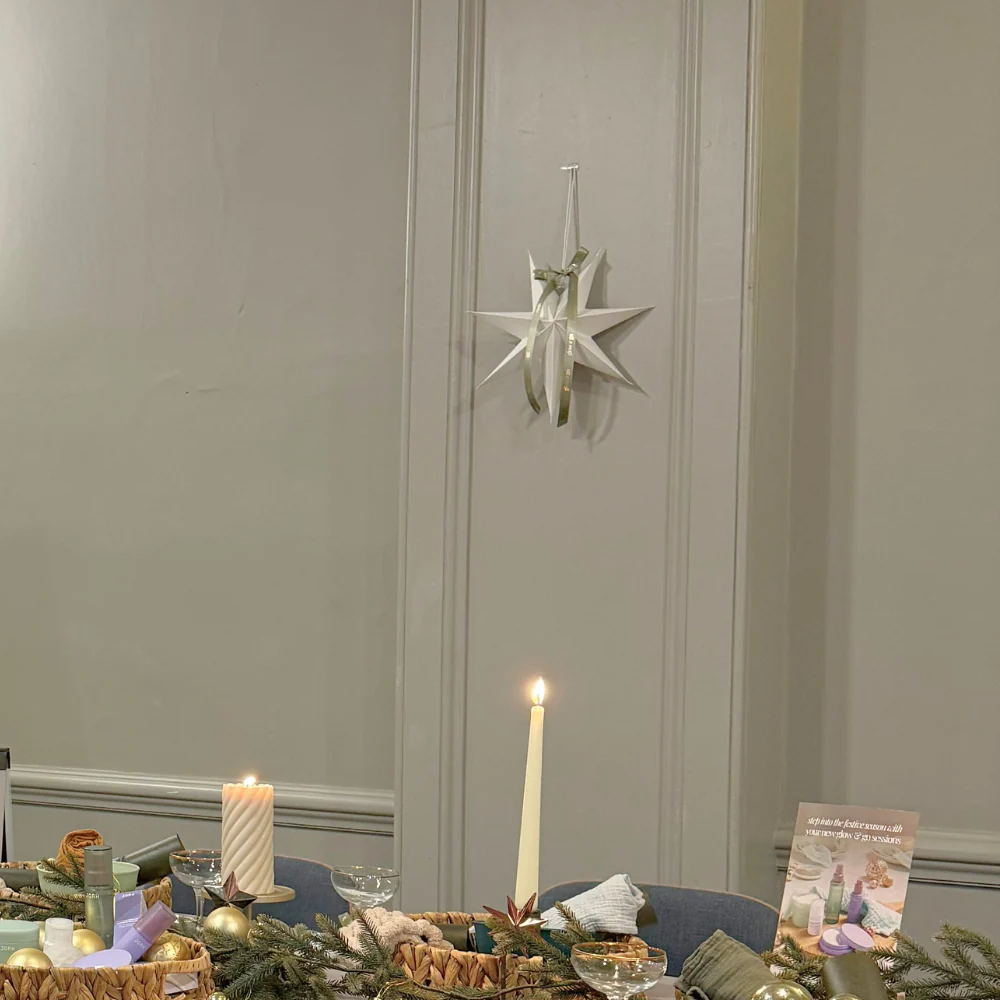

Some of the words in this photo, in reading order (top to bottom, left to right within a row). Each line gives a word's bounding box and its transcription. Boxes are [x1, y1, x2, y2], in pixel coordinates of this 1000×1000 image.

[807, 817, 821, 827] step
[833, 818, 844, 827] the
[843, 819, 865, 830] festive
[805, 828, 821, 837] your
[835, 829, 854, 840] glow
[853, 831, 862, 841] &
[871, 834, 902, 845] sessions
